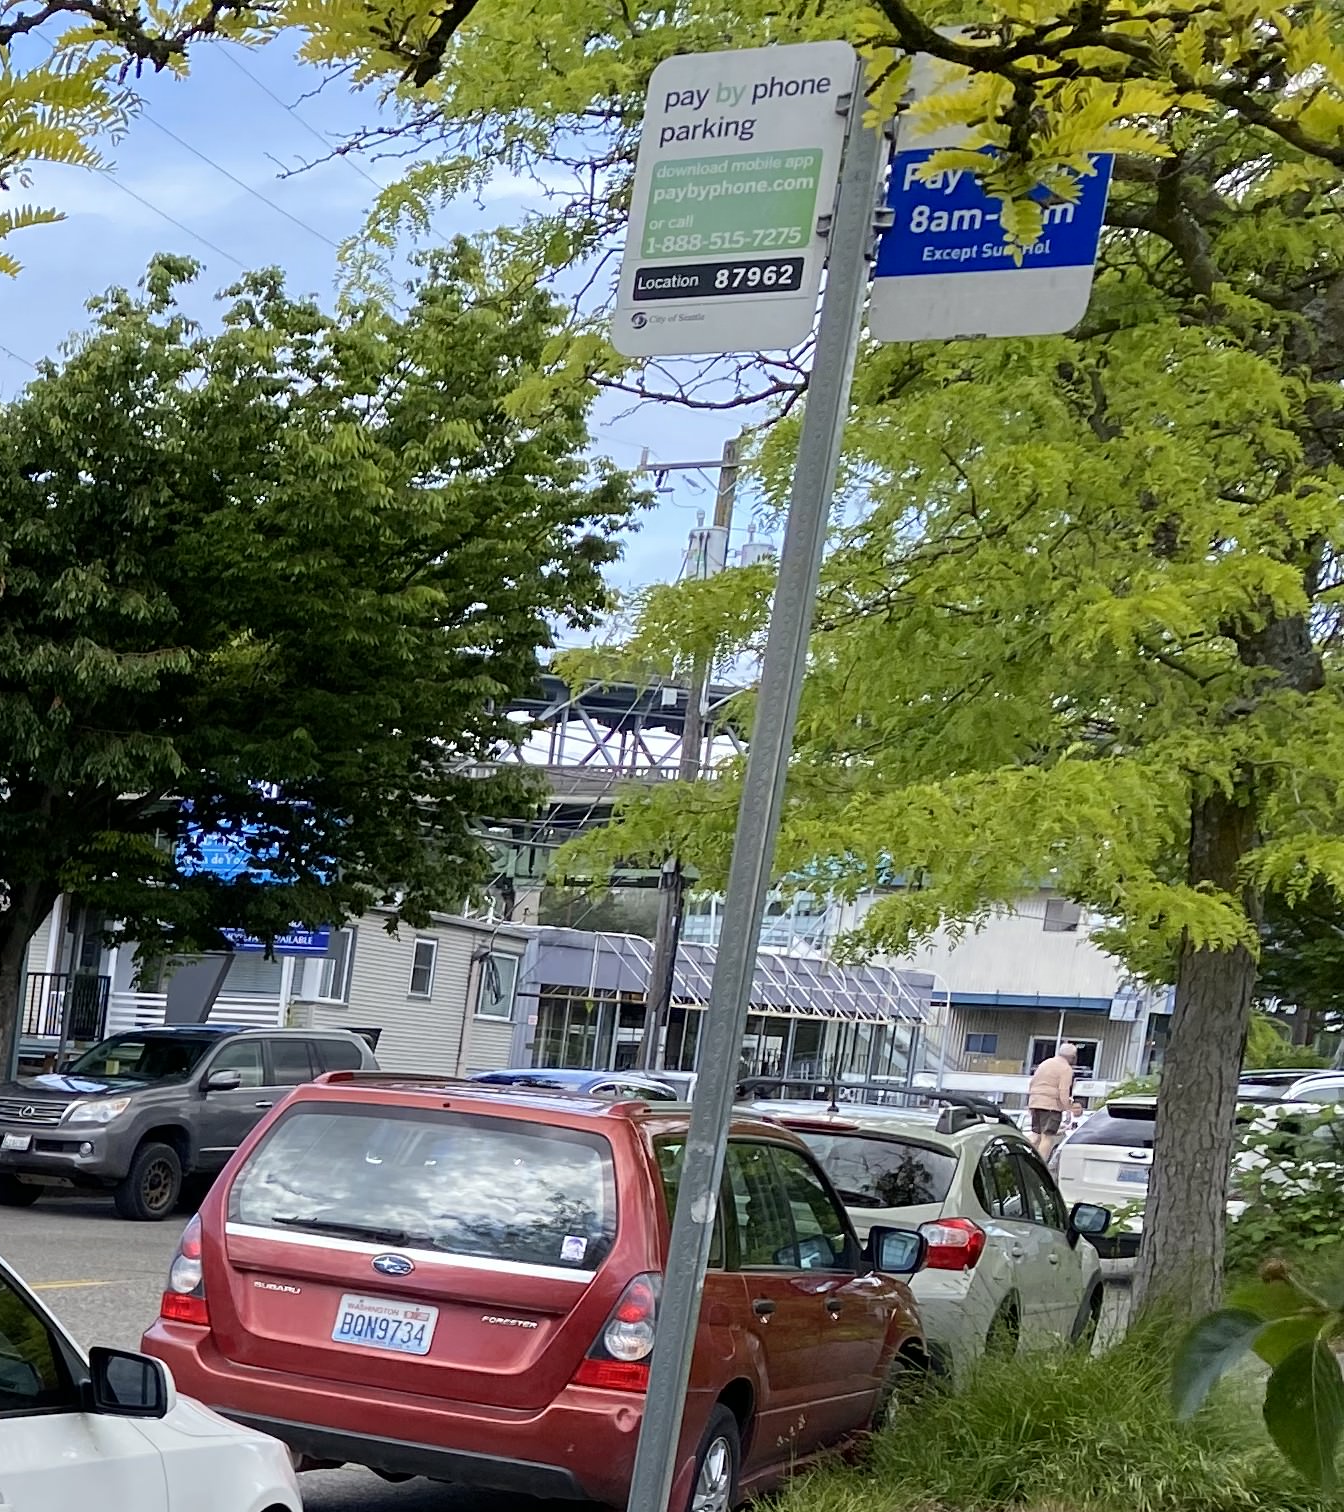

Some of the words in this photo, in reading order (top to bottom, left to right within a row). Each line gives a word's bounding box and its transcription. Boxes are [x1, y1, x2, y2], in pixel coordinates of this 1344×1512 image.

[664, 88, 710, 113] pay
[715, 82, 747, 107] by
[751, 76, 831, 105] phone
[659, 116, 757, 148] parking
[656, 160, 729, 178] download
[731, 156, 782, 172] mobile
[784, 156, 815, 170] app
[653, 177, 814, 204] paybyphone.com
[649, 219, 665, 230] or
[668, 215, 694, 228] call
[646, 227, 802, 253] 1-888-515-7275
[922, 245, 978, 262] Except
[637, 273, 700, 290] Location
[714, 264, 794, 289] 87962
[253, 1280, 302, 1295] SUBARU
[339, 1312, 426, 1347] BQN9734
[481, 1315, 538, 1329] FORESTER
